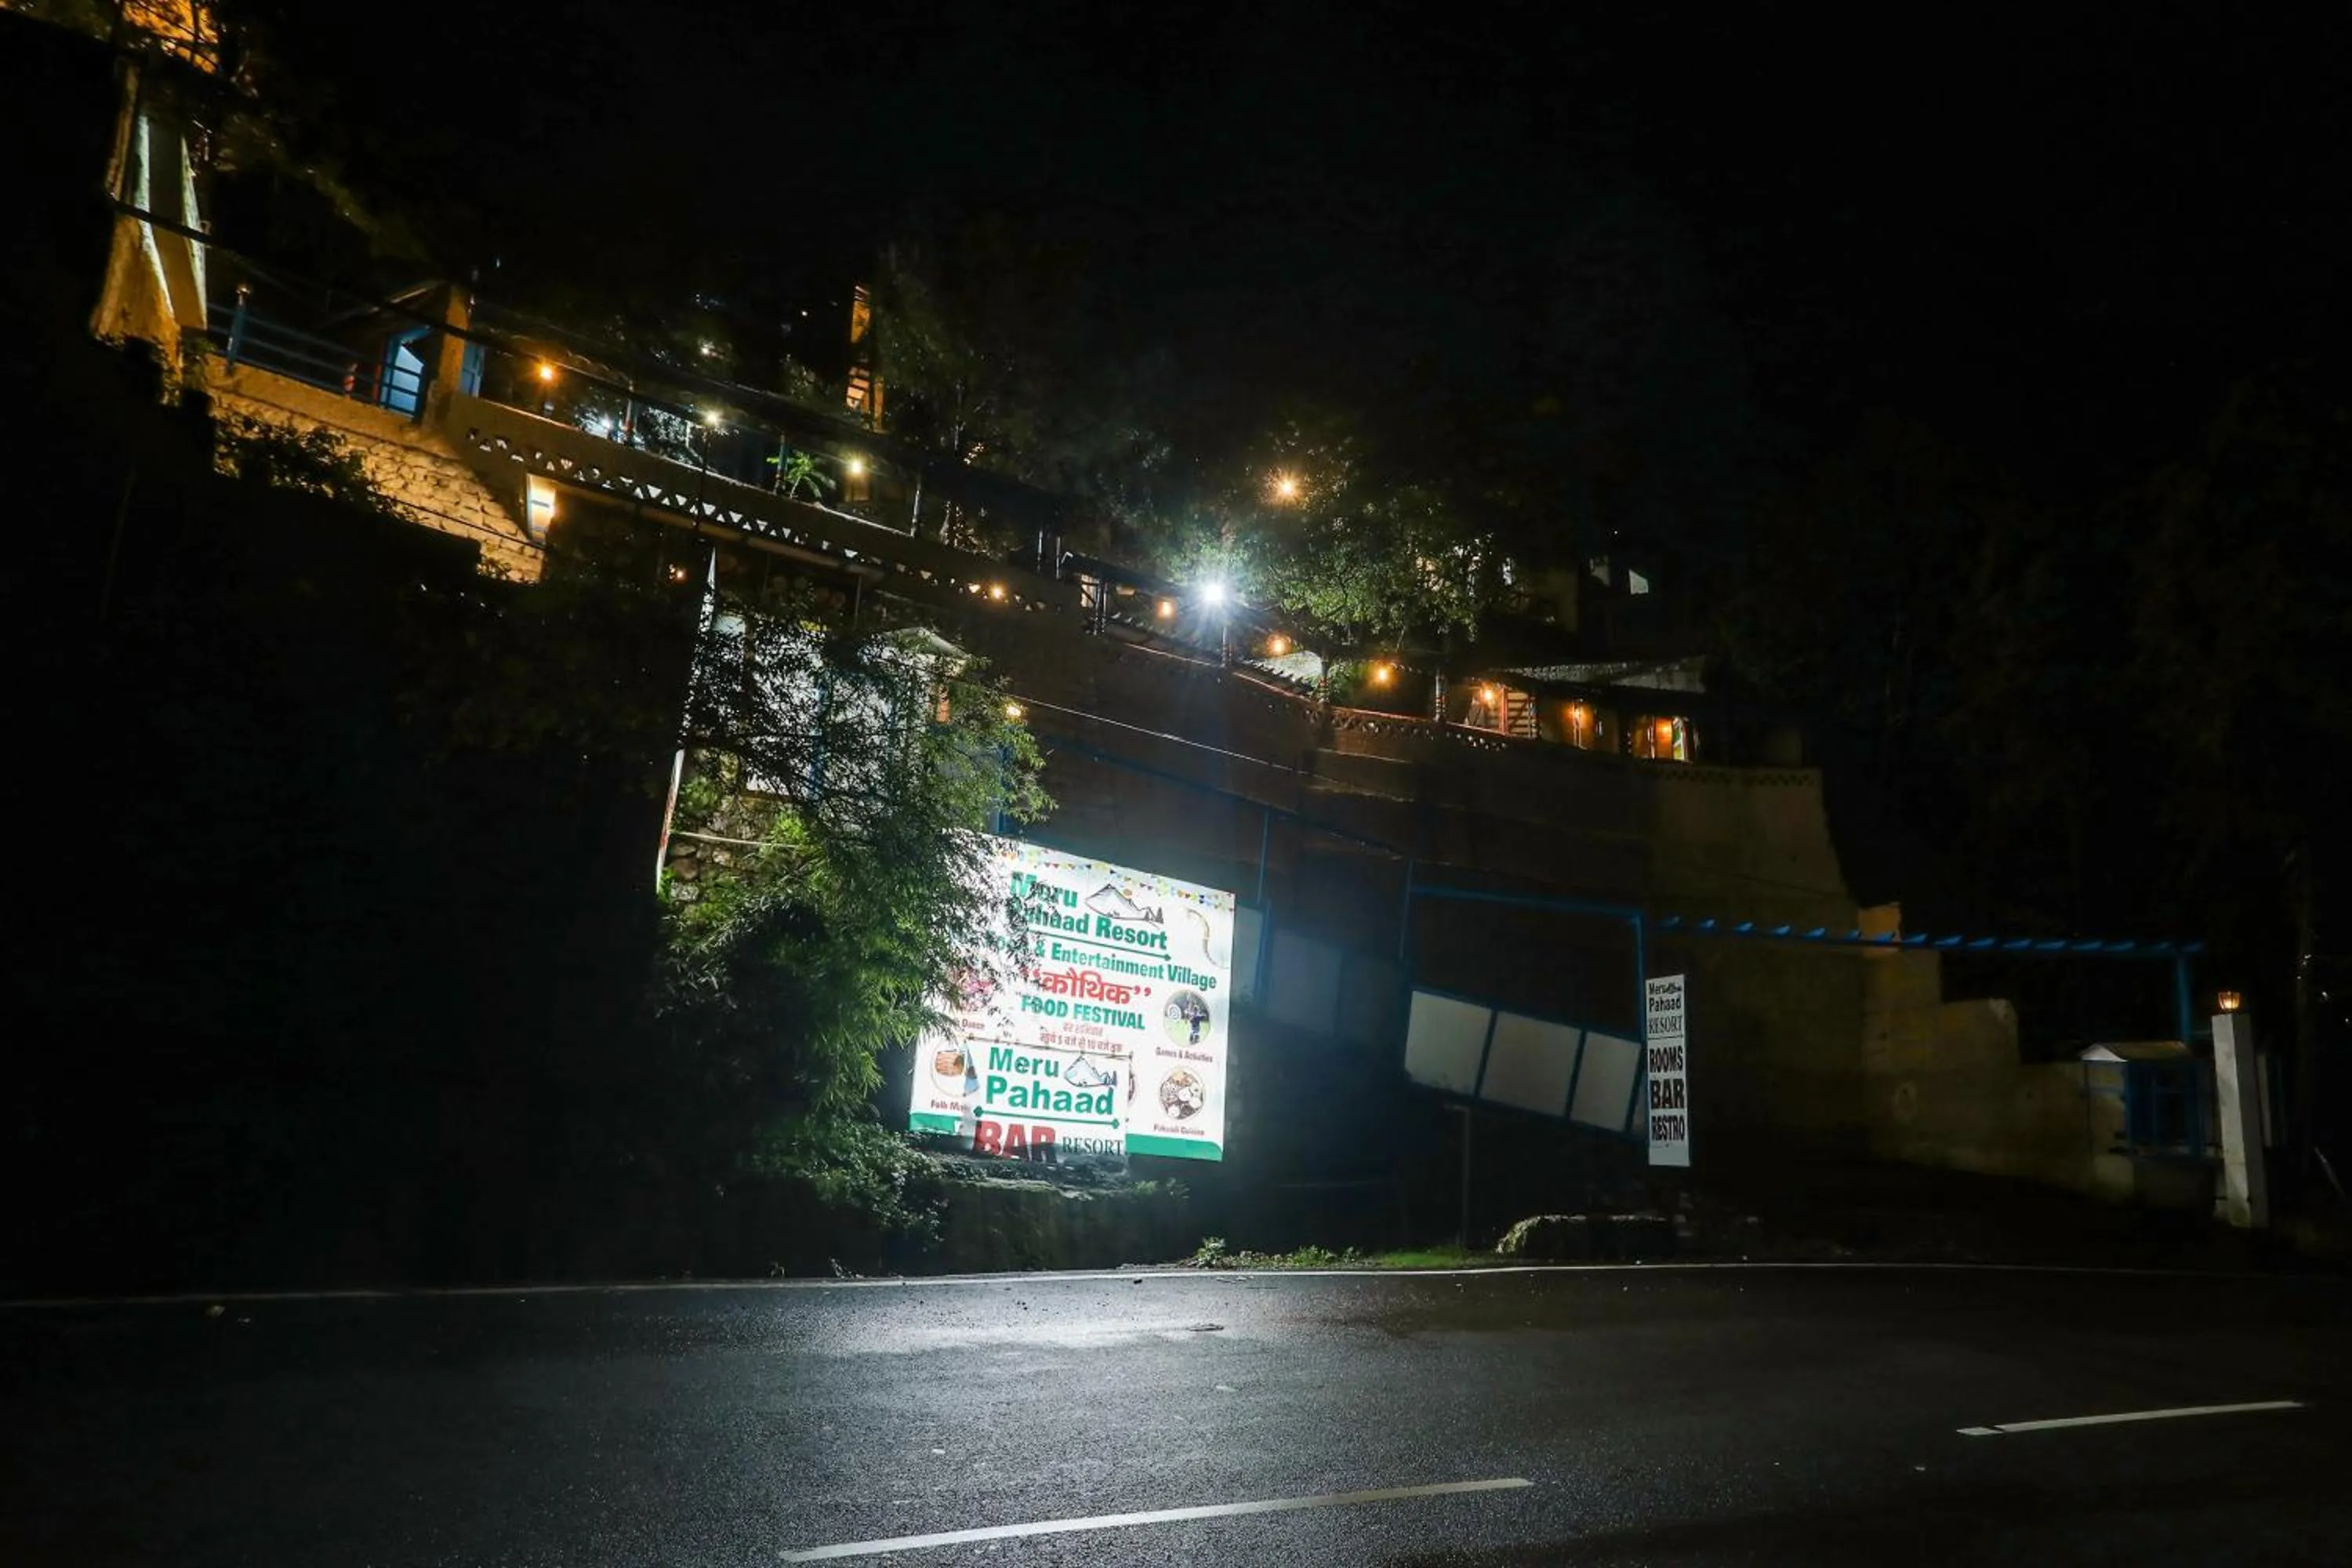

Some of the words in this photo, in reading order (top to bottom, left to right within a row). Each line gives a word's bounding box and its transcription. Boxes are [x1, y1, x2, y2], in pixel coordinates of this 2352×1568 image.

[1007, 897, 1090, 935] ahaad
[1096, 915, 1167, 949] Resort
[1051, 942, 1164, 979] Entertainment
[1167, 964, 1218, 991] Village
[1021, 994, 1069, 1018] FOOD
[1073, 1003, 1145, 1029] FESTIVAL
[1649, 995, 1682, 1012] Pahaad
[1649, 1015, 1682, 1033] RESORT
[989, 1047, 1059, 1077] Meru
[1650, 1046, 1683, 1073] ROOMS
[986, 1075, 1113, 1115] Pahaad
[1650, 1079, 1684, 1109] BAR
[975, 1120, 1057, 1163] BAR
[1062, 1136, 1123, 1155] RESORT
[1652, 1116, 1685, 1141] RESTRO
